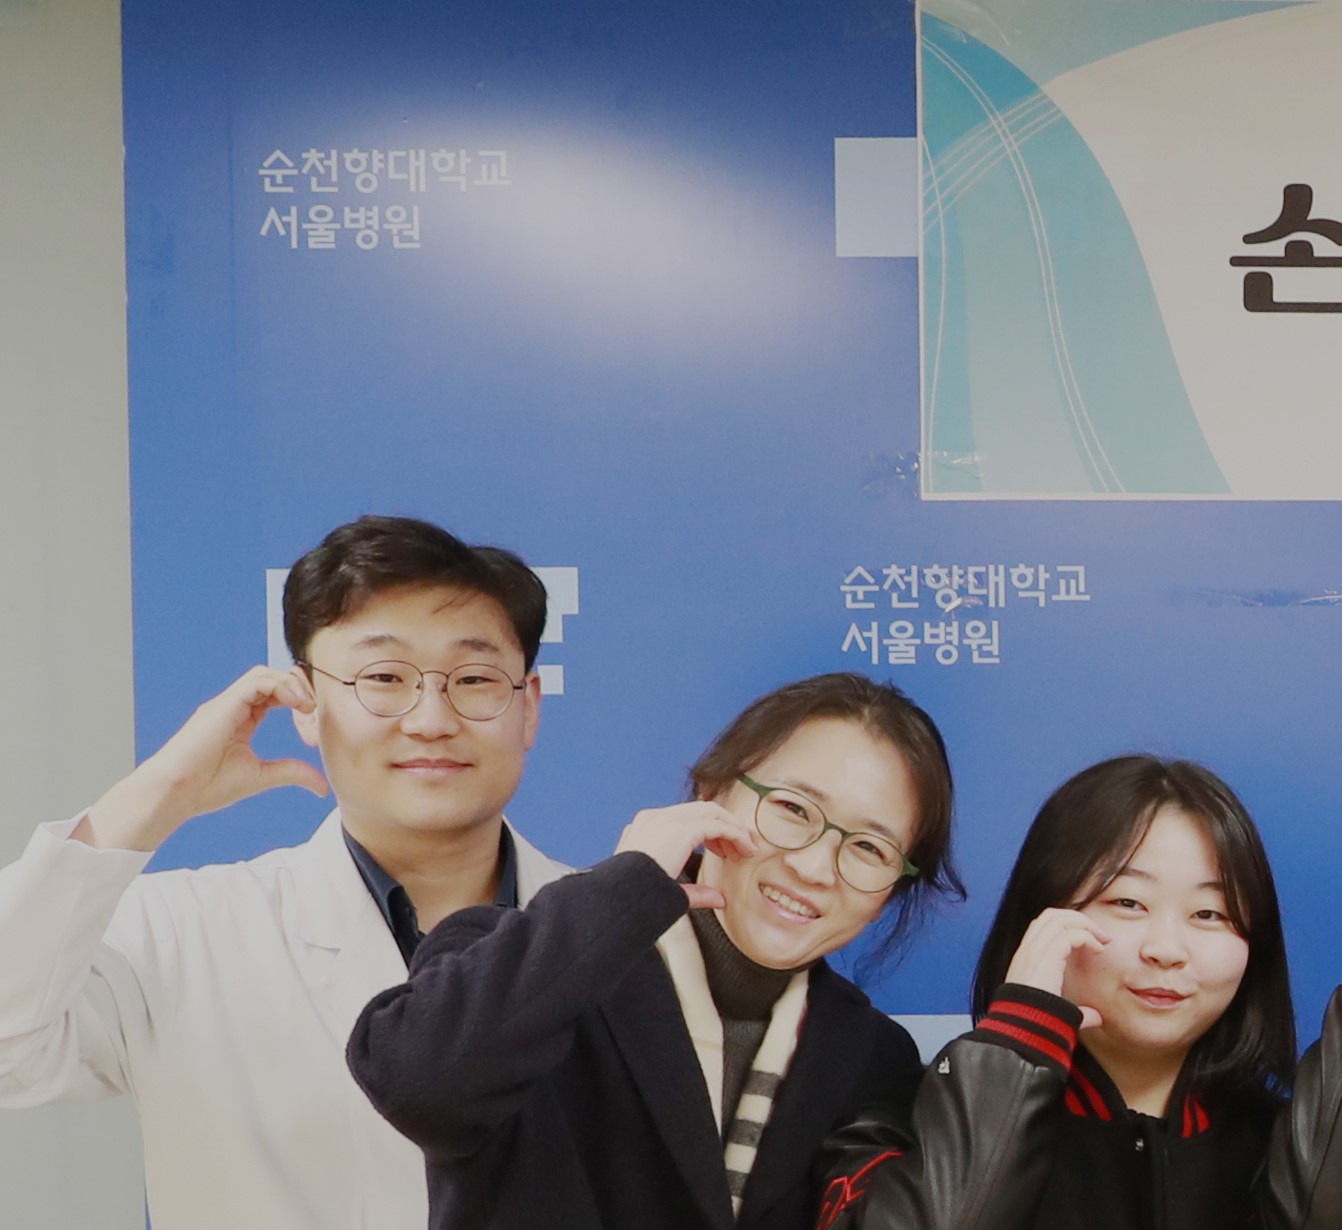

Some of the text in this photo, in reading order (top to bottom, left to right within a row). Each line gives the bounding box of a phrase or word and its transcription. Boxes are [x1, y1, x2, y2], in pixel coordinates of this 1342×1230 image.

[257, 147, 513, 193] 순천향대학교
[260, 204, 422, 250] 서울병원
[839, 563, 1091, 608] 순천향대학교
[840, 619, 1002, 665] 서울병원
